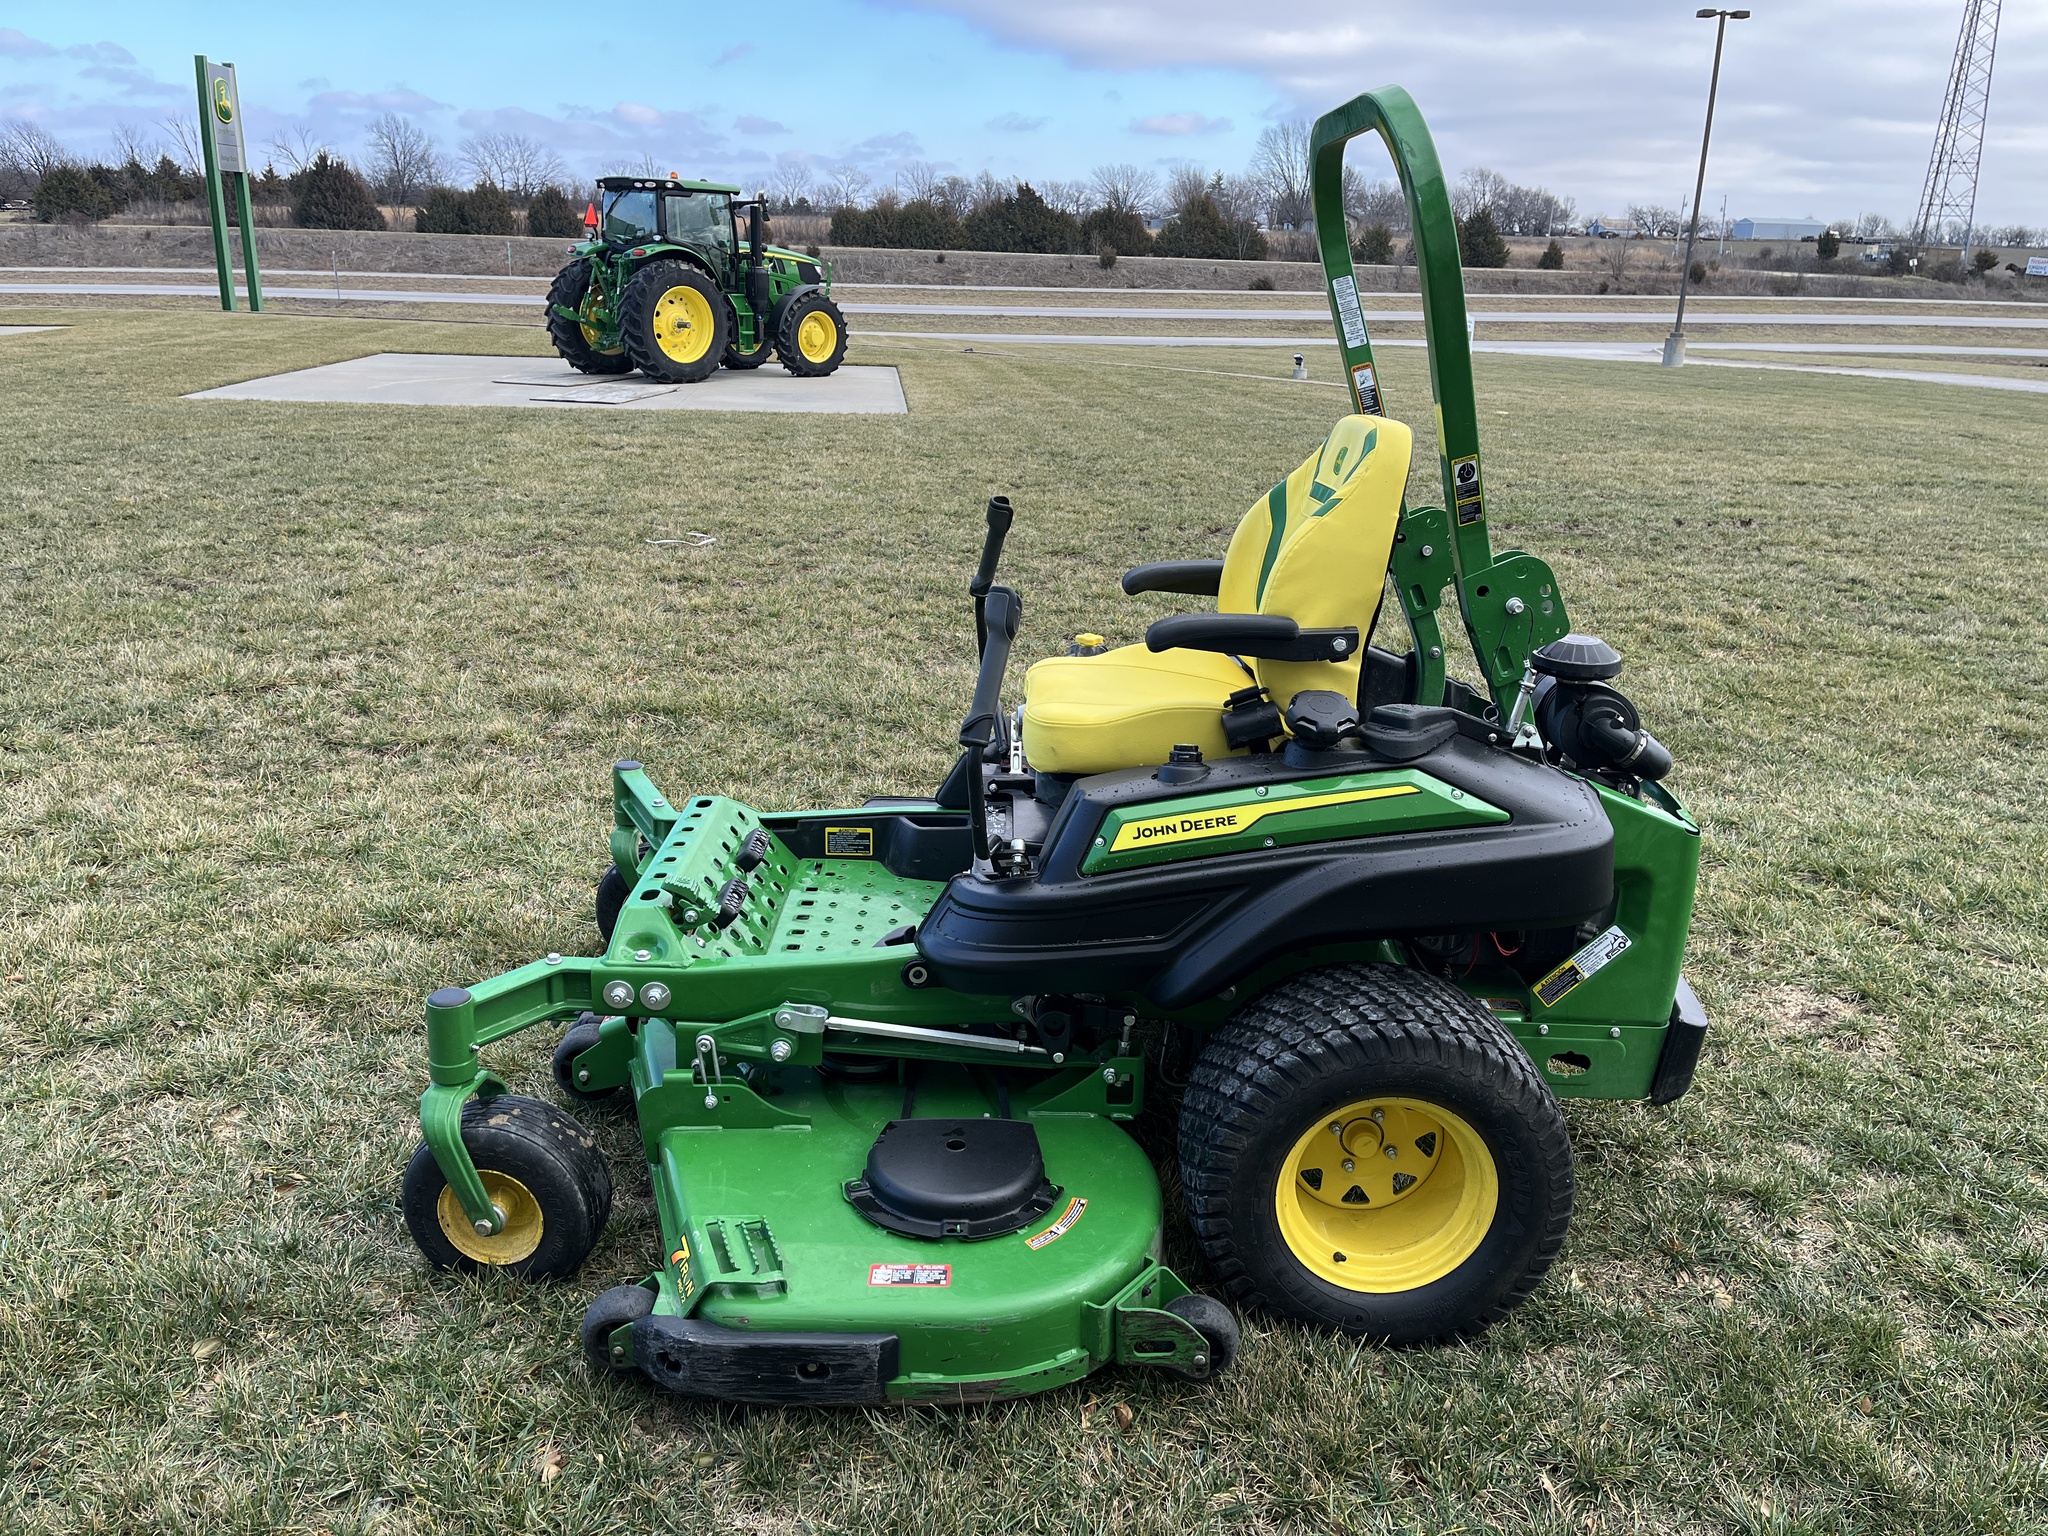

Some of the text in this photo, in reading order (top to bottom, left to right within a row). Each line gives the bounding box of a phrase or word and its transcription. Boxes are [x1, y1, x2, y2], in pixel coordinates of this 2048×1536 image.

[1132, 815, 1237, 840] JOHN DEERE
[1488, 1127, 1532, 1238] KENDA
